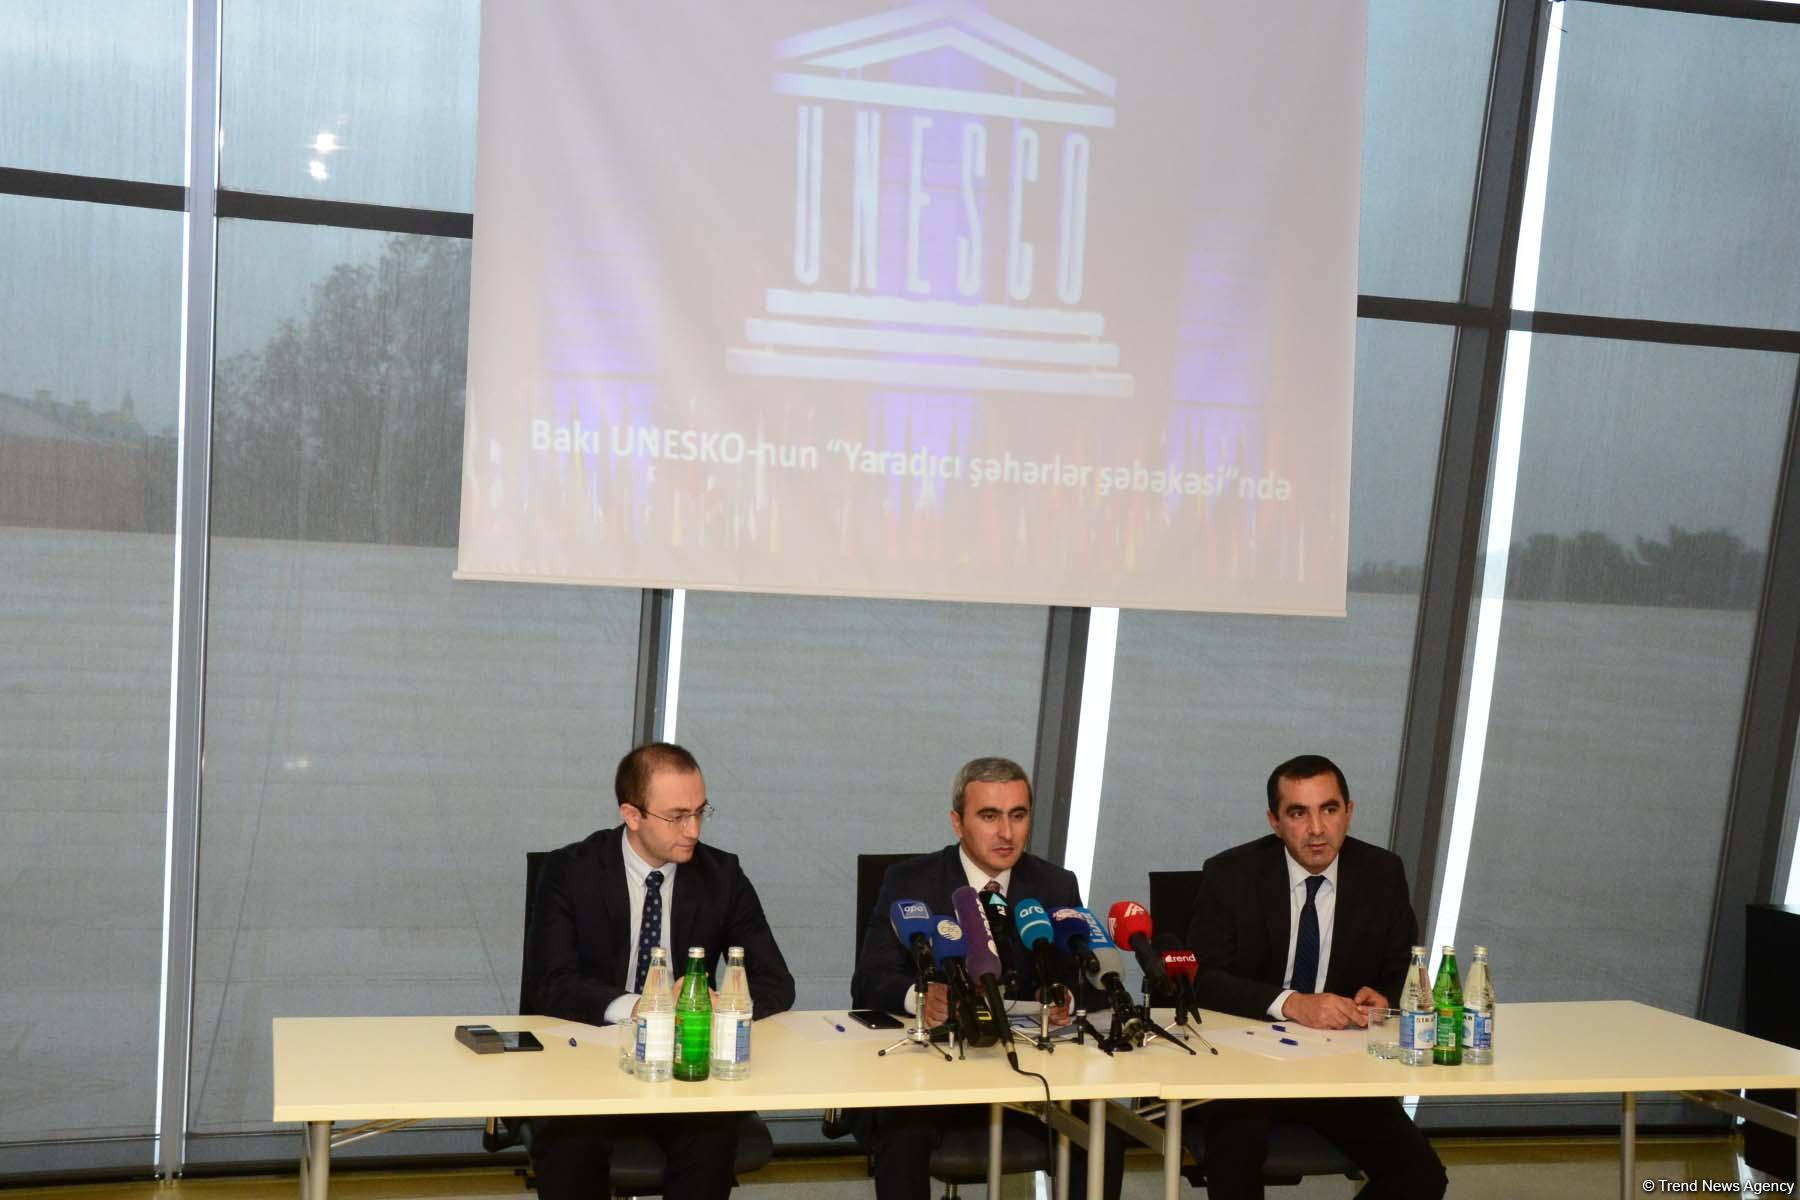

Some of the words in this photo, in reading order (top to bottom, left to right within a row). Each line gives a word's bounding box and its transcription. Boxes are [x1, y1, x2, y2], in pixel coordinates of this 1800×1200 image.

[795, 105, 1090, 304] UNESCO
[531, 419, 599, 454] Bakı
[611, 425, 818, 469] UNESKO-nun
[969, 453, 1092, 488] şəhərlər
